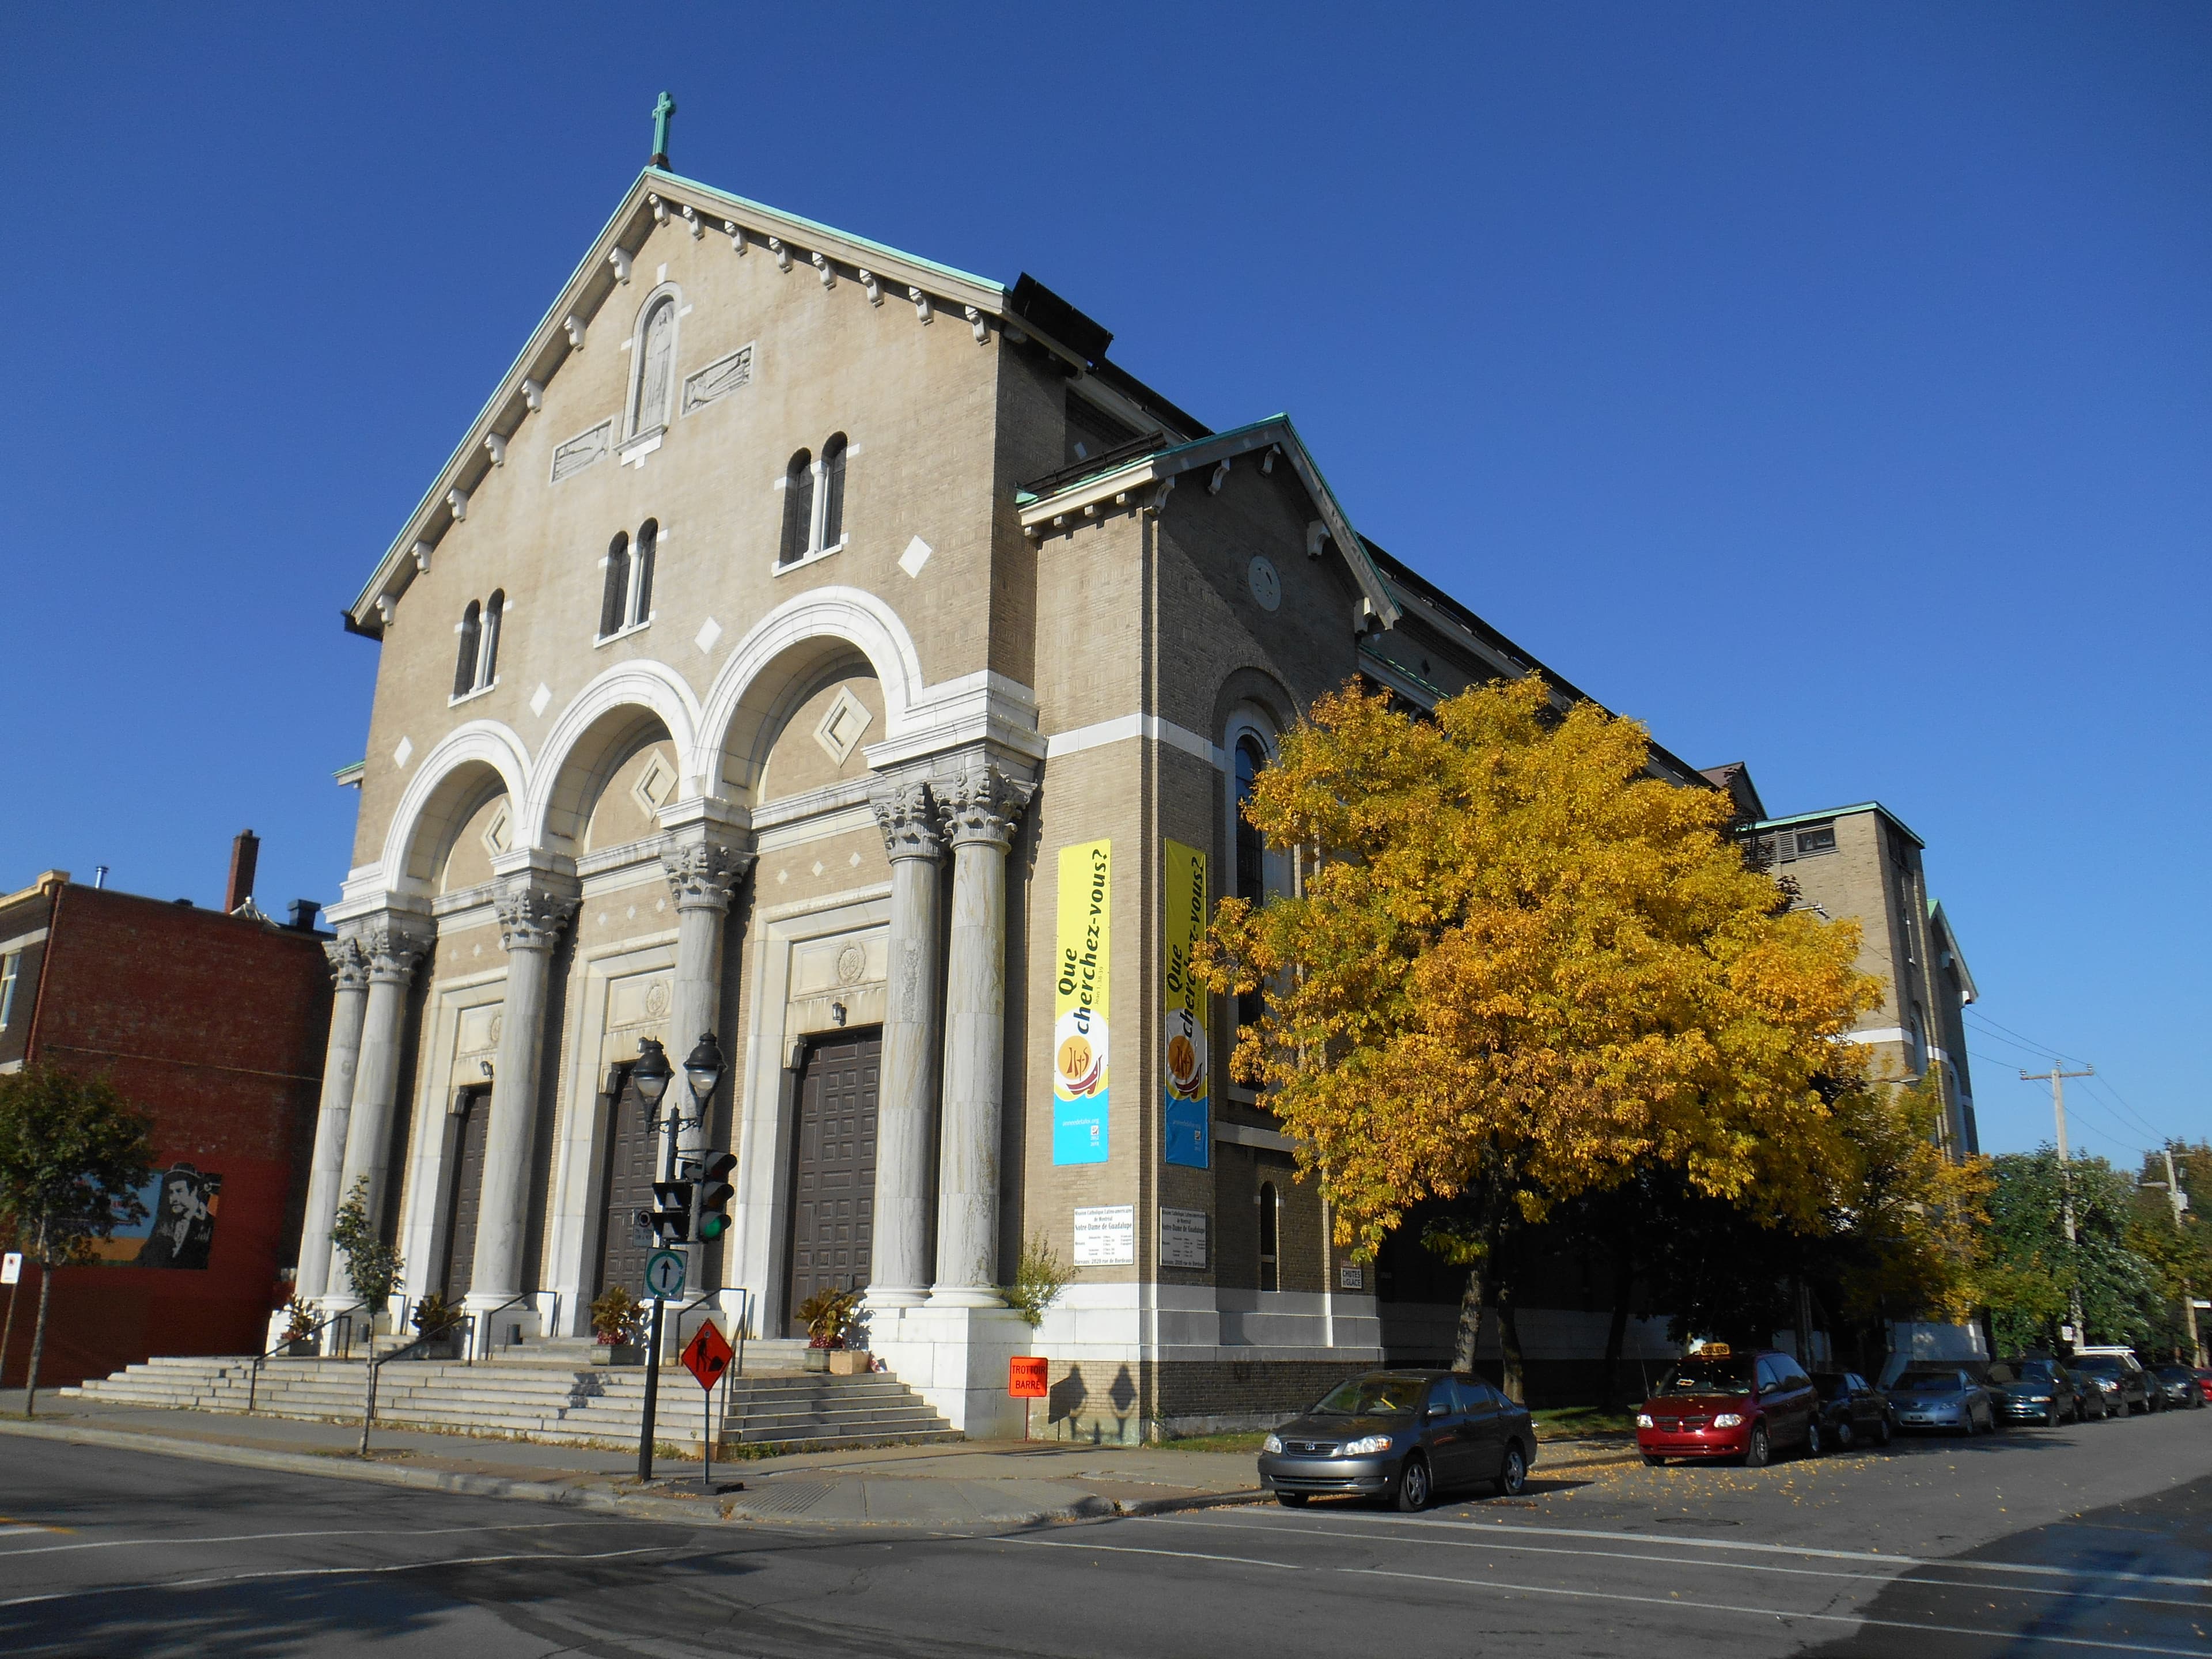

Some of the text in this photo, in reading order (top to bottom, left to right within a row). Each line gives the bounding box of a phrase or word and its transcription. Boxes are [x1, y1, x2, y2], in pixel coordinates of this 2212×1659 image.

[1074, 849, 1107, 1034] cherchez-vous?
[1059, 948, 1077, 995] Que
[1168, 944, 1183, 993] Que
[1108, 1222, 1132, 1230] Guadalupe
[1343, 1270, 1360, 1278] CHUTES
[1012, 1365, 1046, 1374] TROTTOIR
